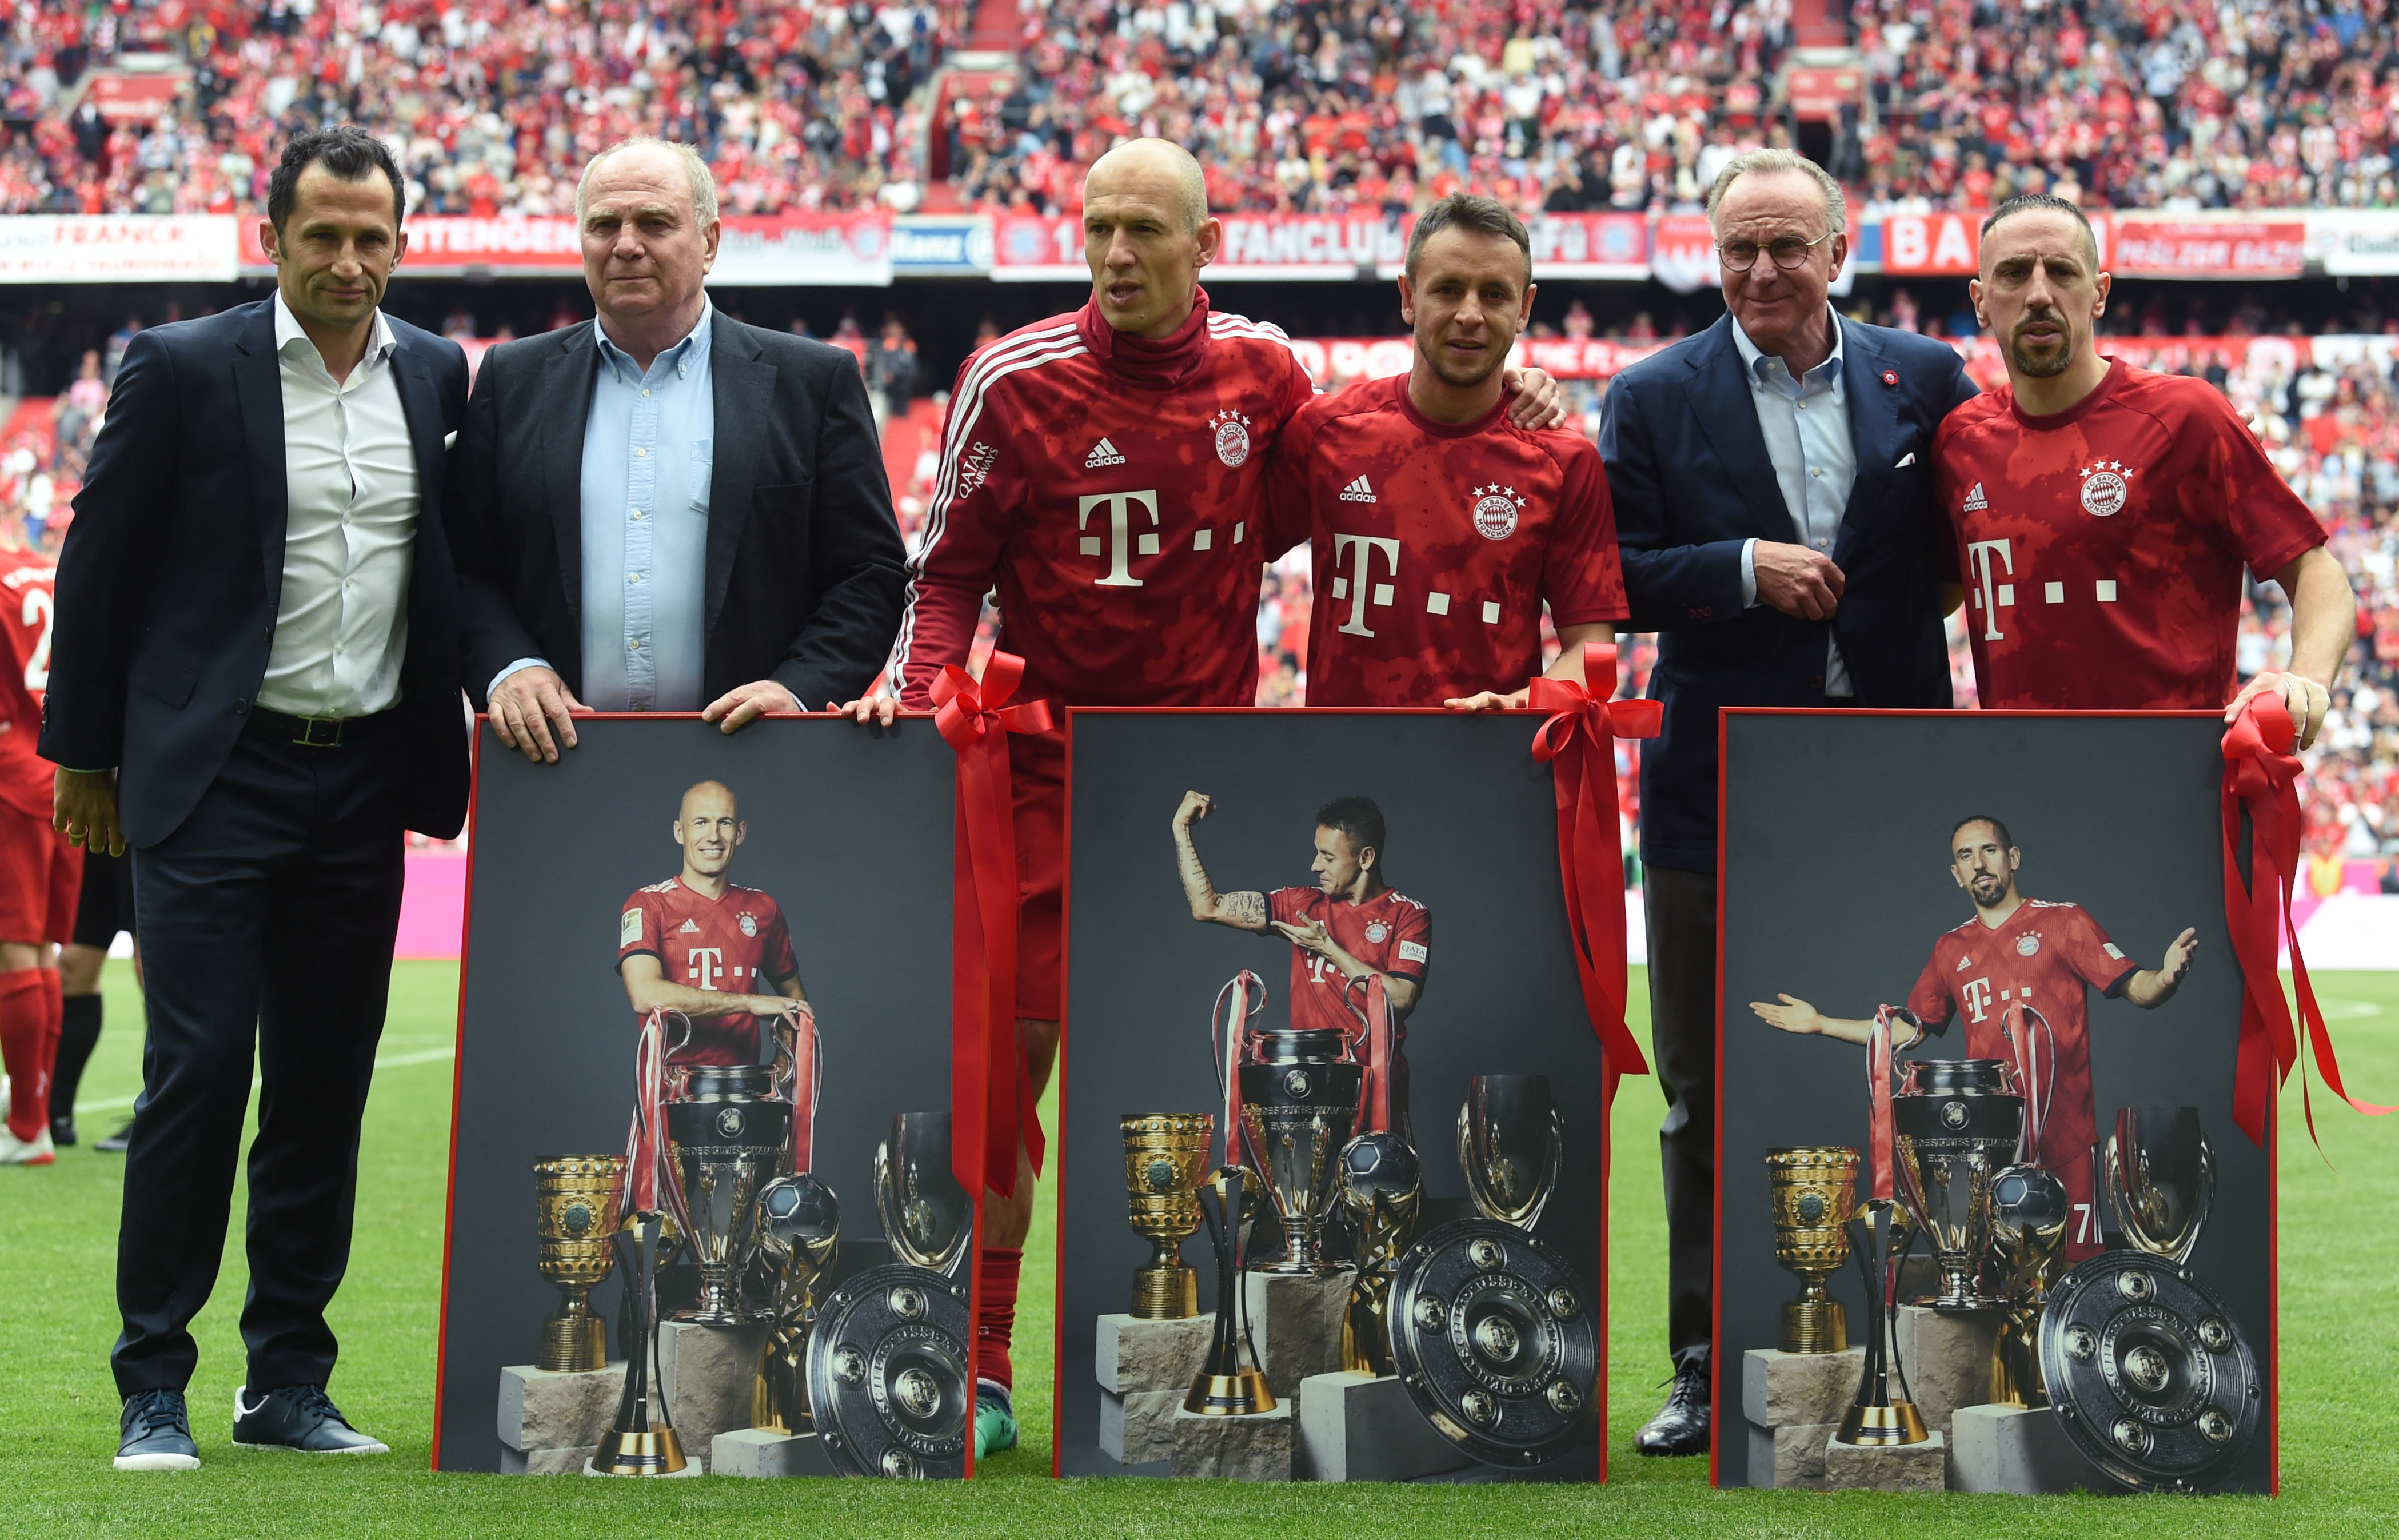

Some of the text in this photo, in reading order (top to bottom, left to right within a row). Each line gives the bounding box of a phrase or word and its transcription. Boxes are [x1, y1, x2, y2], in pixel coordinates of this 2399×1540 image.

[1224, 220, 1404, 262] FANCLUB
[1218, 425, 1246, 442] FC BAYERN
[959, 441, 990, 499] QATAR
[973, 447, 999, 489] AIRWAYS
[1085, 454, 1125, 468] adidas
[1339, 490, 1376, 504] adidas
[2086, 476, 2122, 492] FC BAYERN
[1478, 499, 1514, 518] FC BAYERN
[1963, 499, 1988, 512] adidas
[1079, 489, 1160, 587] T
[1332, 533, 1400, 639] T
[1967, 538, 2015, 641] T
[689, 948, 723, 990] T
[1402, 944, 1425, 956] QATA
[1962, 976, 1991, 1024] T
[2073, 1204, 2090, 1244] 7
